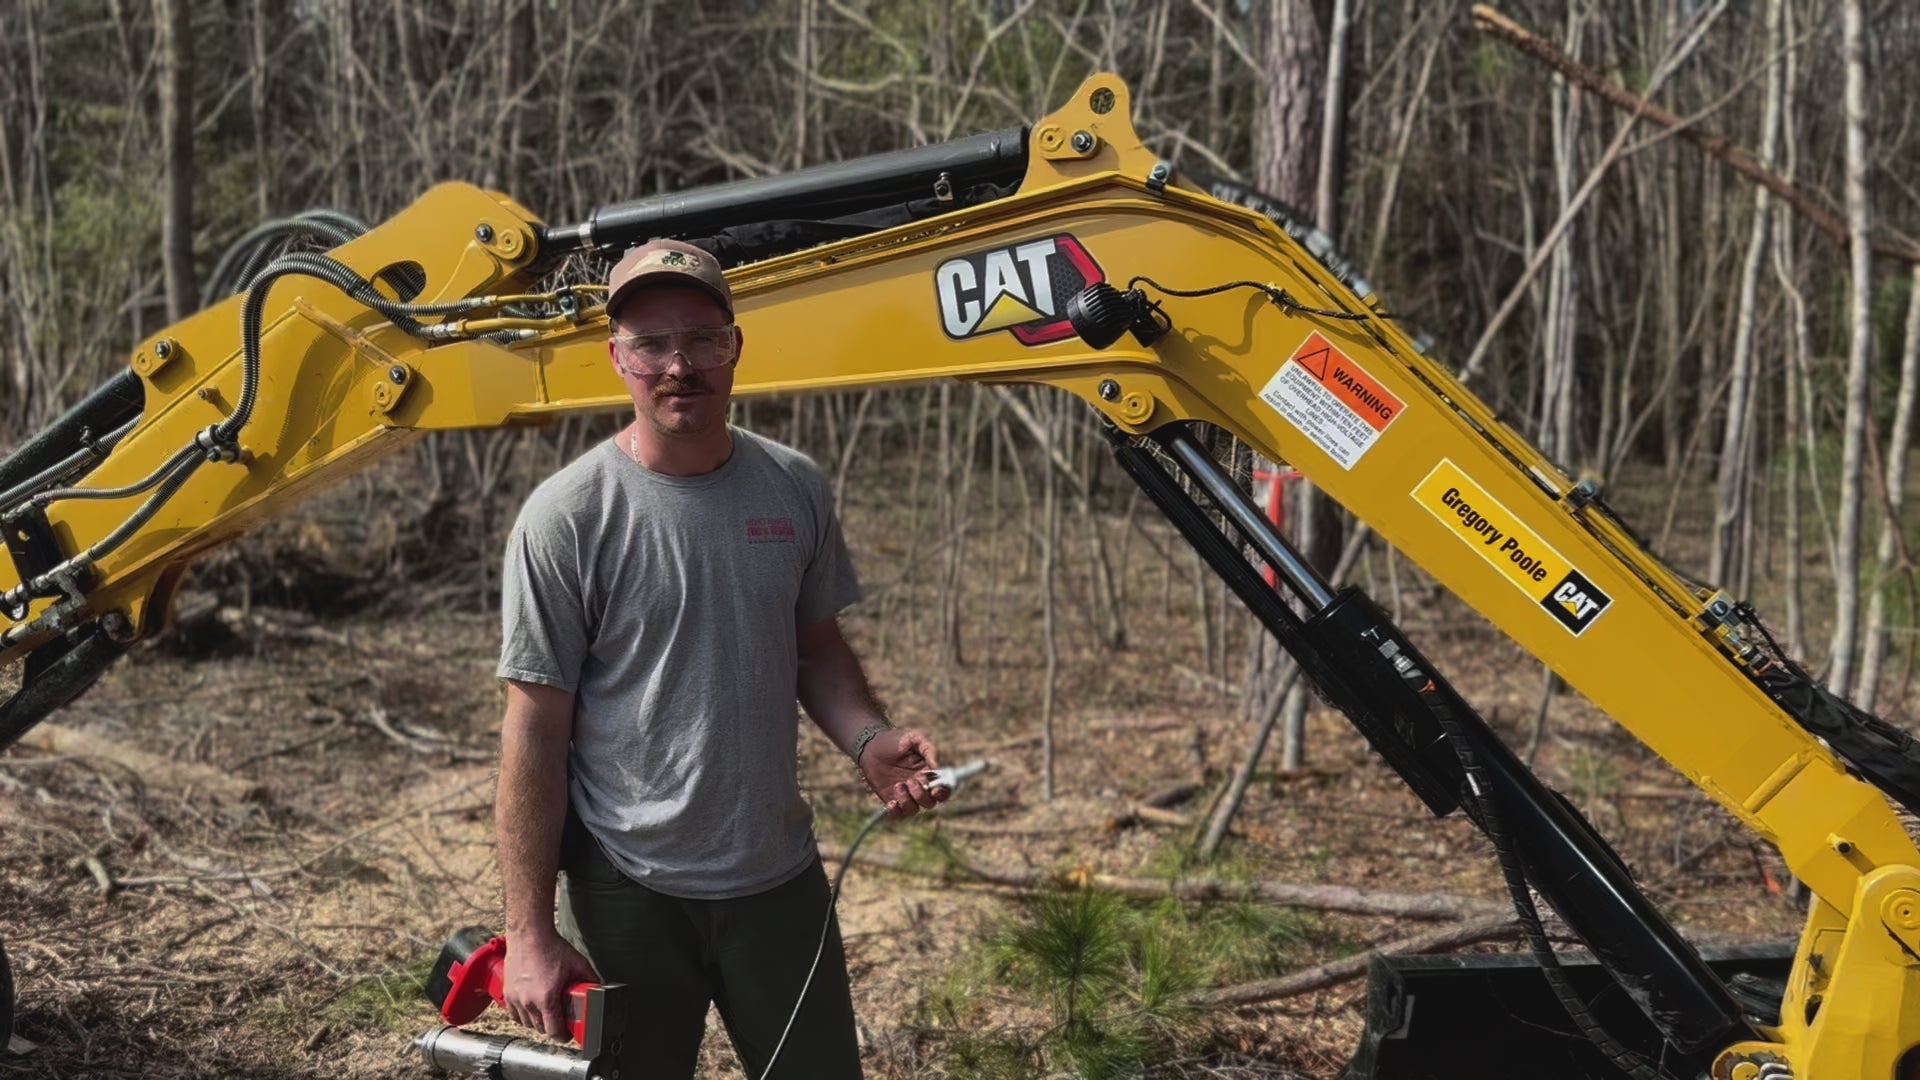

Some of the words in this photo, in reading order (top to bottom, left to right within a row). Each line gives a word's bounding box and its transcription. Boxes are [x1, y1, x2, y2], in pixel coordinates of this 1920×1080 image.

[937, 238, 1056, 336] CAT
[1273, 390, 1296, 411] Contact
[1294, 410, 1307, 421] with
[1306, 420, 1325, 435] power
[1324, 434, 1339, 448] lines
[1339, 447, 1350, 457] can
[1280, 376, 1289, 385] OF
[1289, 385, 1322, 413] OVERHEAD
[1285, 371, 1321, 401] EQUIPMENT
[1319, 399, 1341, 419] WITHIN
[1340, 416, 1353, 429] TEN
[1352, 427, 1369, 441] FEET
[1291, 366, 1323, 395] UNLAWFUL
[1323, 391, 1333, 401] TO
[1332, 400, 1360, 425] OPERATE
[1360, 422, 1374, 436] THIS
[1306, 408, 1324, 425] LINES
[1333, 367, 1393, 421] WARNING
[1442, 487, 1503, 545] Gregory
[1499, 537, 1547, 582] Poole
[1553, 581, 1599, 620] CAT
